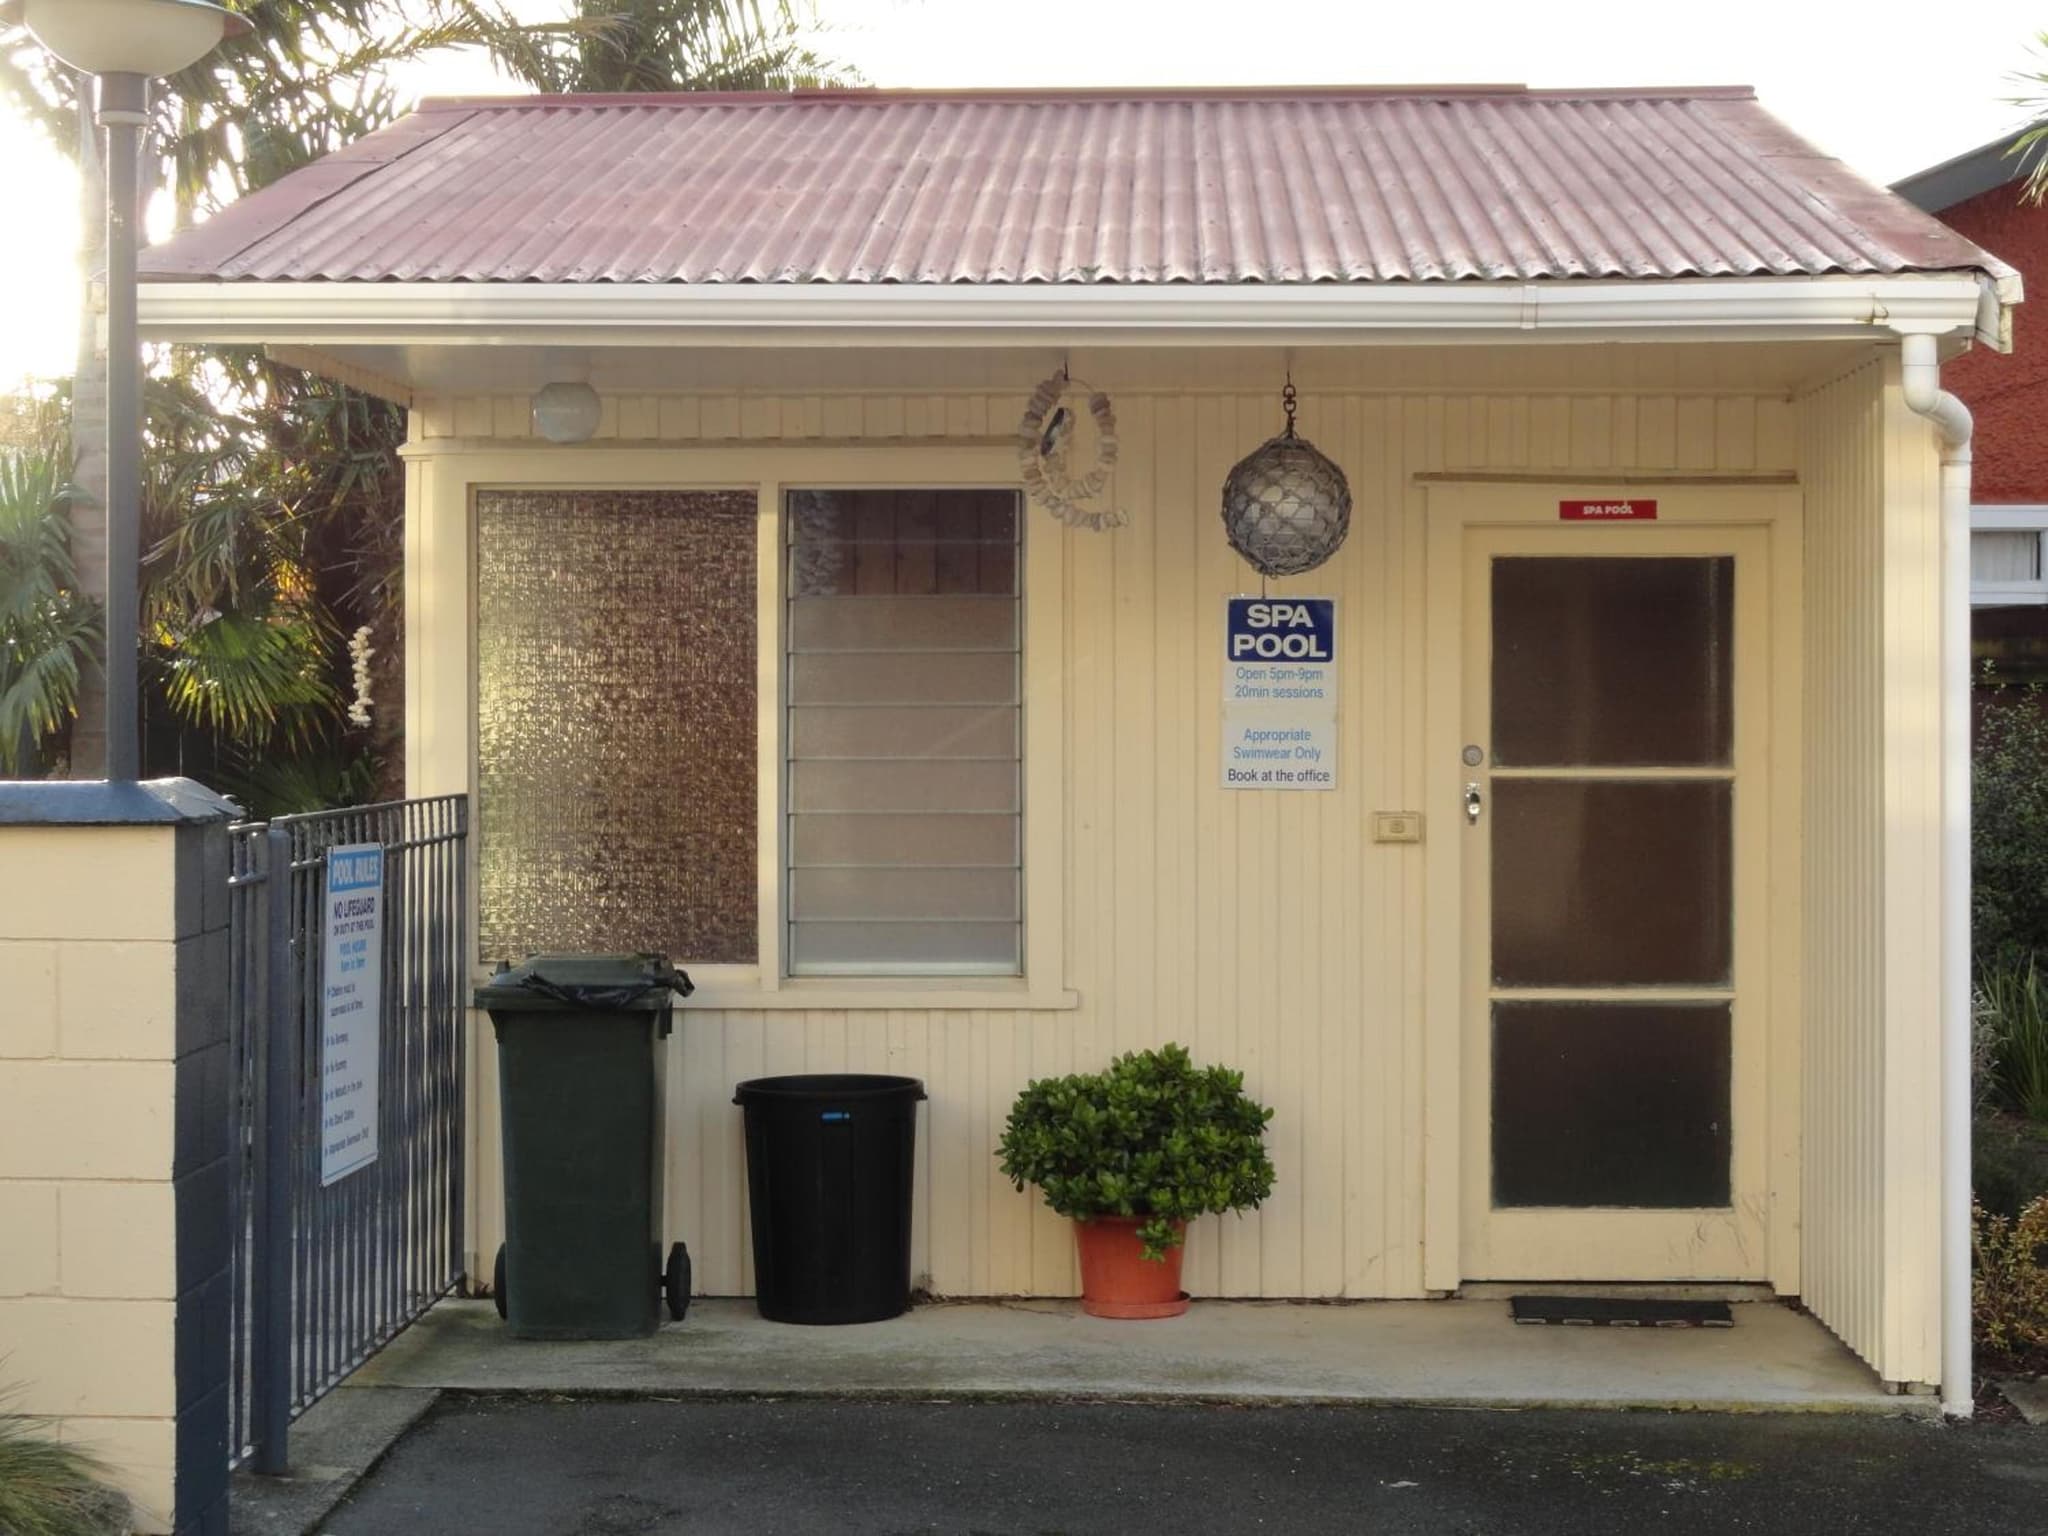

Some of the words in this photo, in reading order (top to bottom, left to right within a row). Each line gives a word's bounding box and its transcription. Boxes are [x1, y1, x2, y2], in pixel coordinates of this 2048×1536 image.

[1583, 505, 1603, 515] SPA
[1605, 505, 1633, 515] POOL
[1247, 603, 1314, 628] SPA
[1233, 633, 1327, 658] POOL
[1236, 667, 1267, 682] Open
[1270, 667, 1323, 682] 5pm-9pm
[1234, 685, 1269, 698] 20min
[1272, 685, 1324, 698] sessions
[1244, 728, 1312, 744] Appropriate
[1233, 746, 1292, 760] Swimwear
[1294, 746, 1321, 762] Only
[1228, 768, 1258, 782] Book
[1261, 770, 1273, 782] at
[1275, 769, 1295, 782] the
[1297, 769, 1331, 782] office
[332, 859, 354, 886] POOL
[355, 855, 379, 882] RULES
[334, 901, 343, 919] NO
[344, 897, 375, 917] LIFEGUARD
